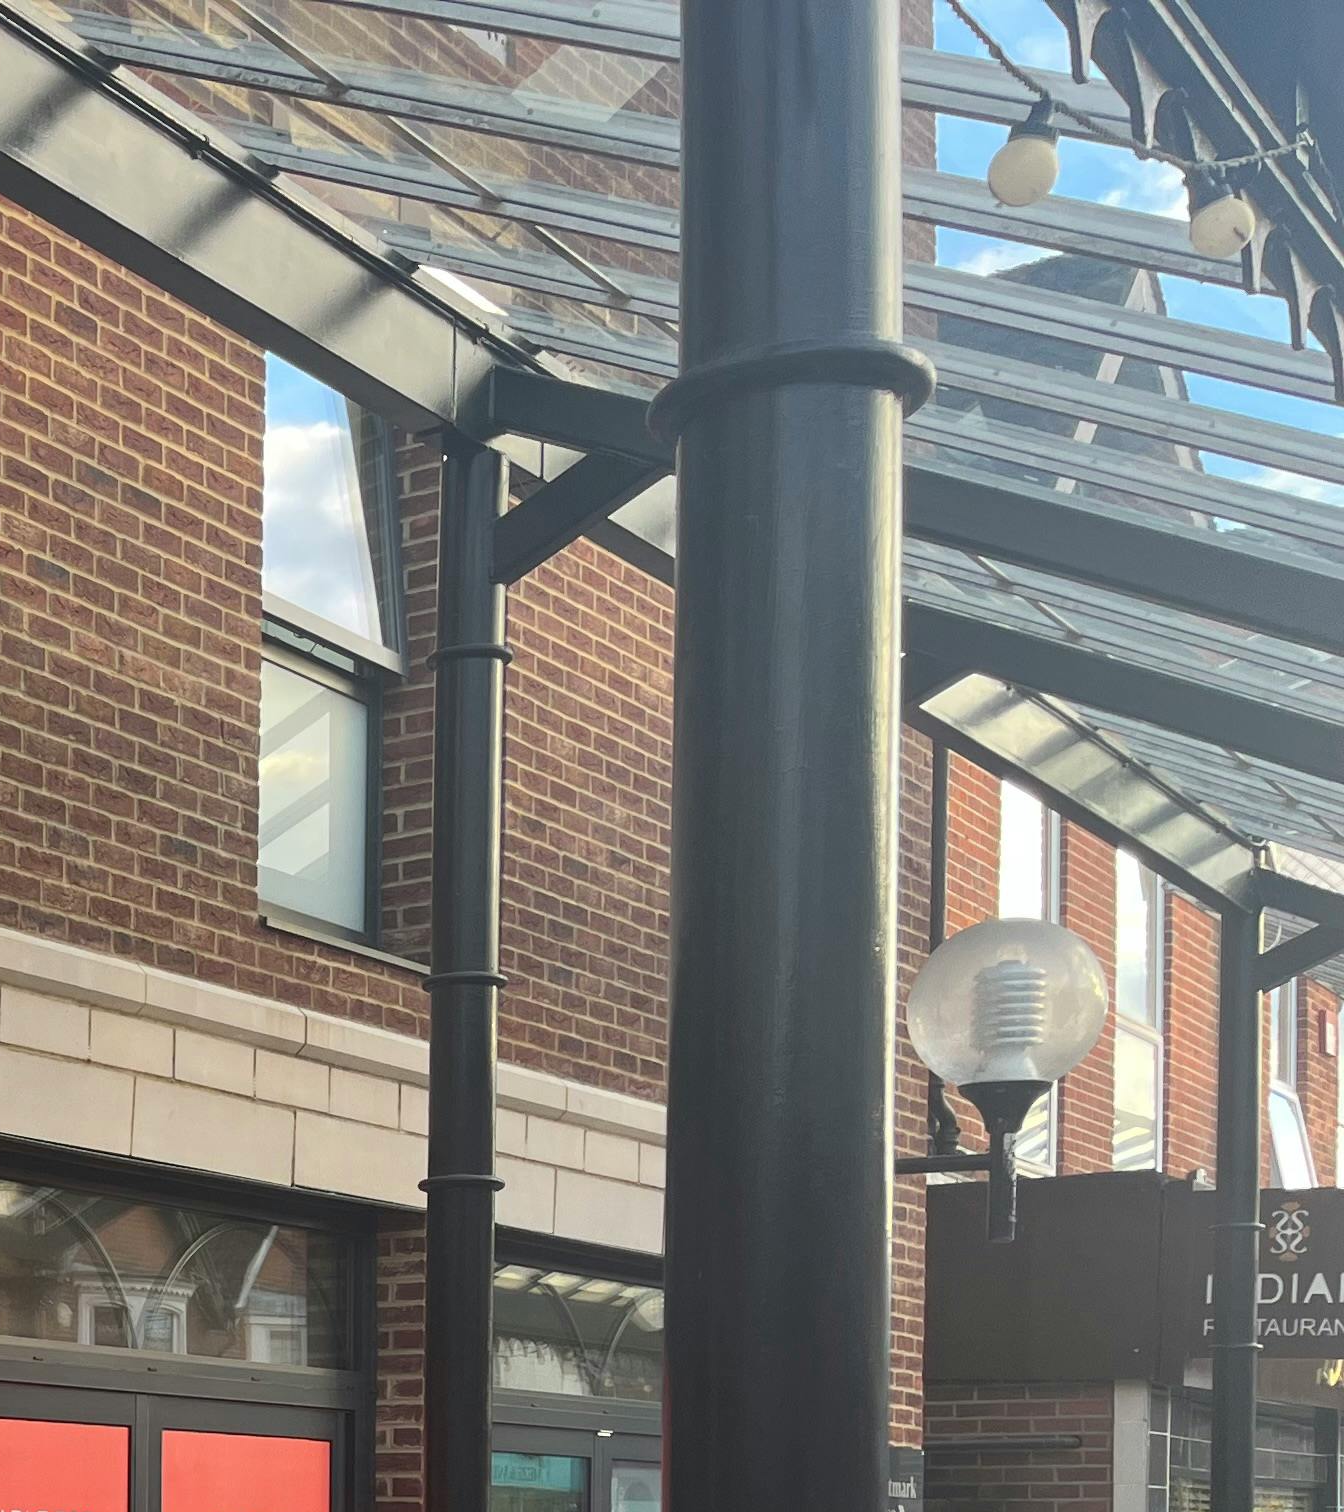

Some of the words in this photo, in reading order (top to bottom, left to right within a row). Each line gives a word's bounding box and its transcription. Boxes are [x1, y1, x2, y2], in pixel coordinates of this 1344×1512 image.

[1205, 1273, 1344, 1304] IDIA
[1203, 1318, 1344, 1337] RTAURAN
[888, 1476, 916, 1499] tmark
